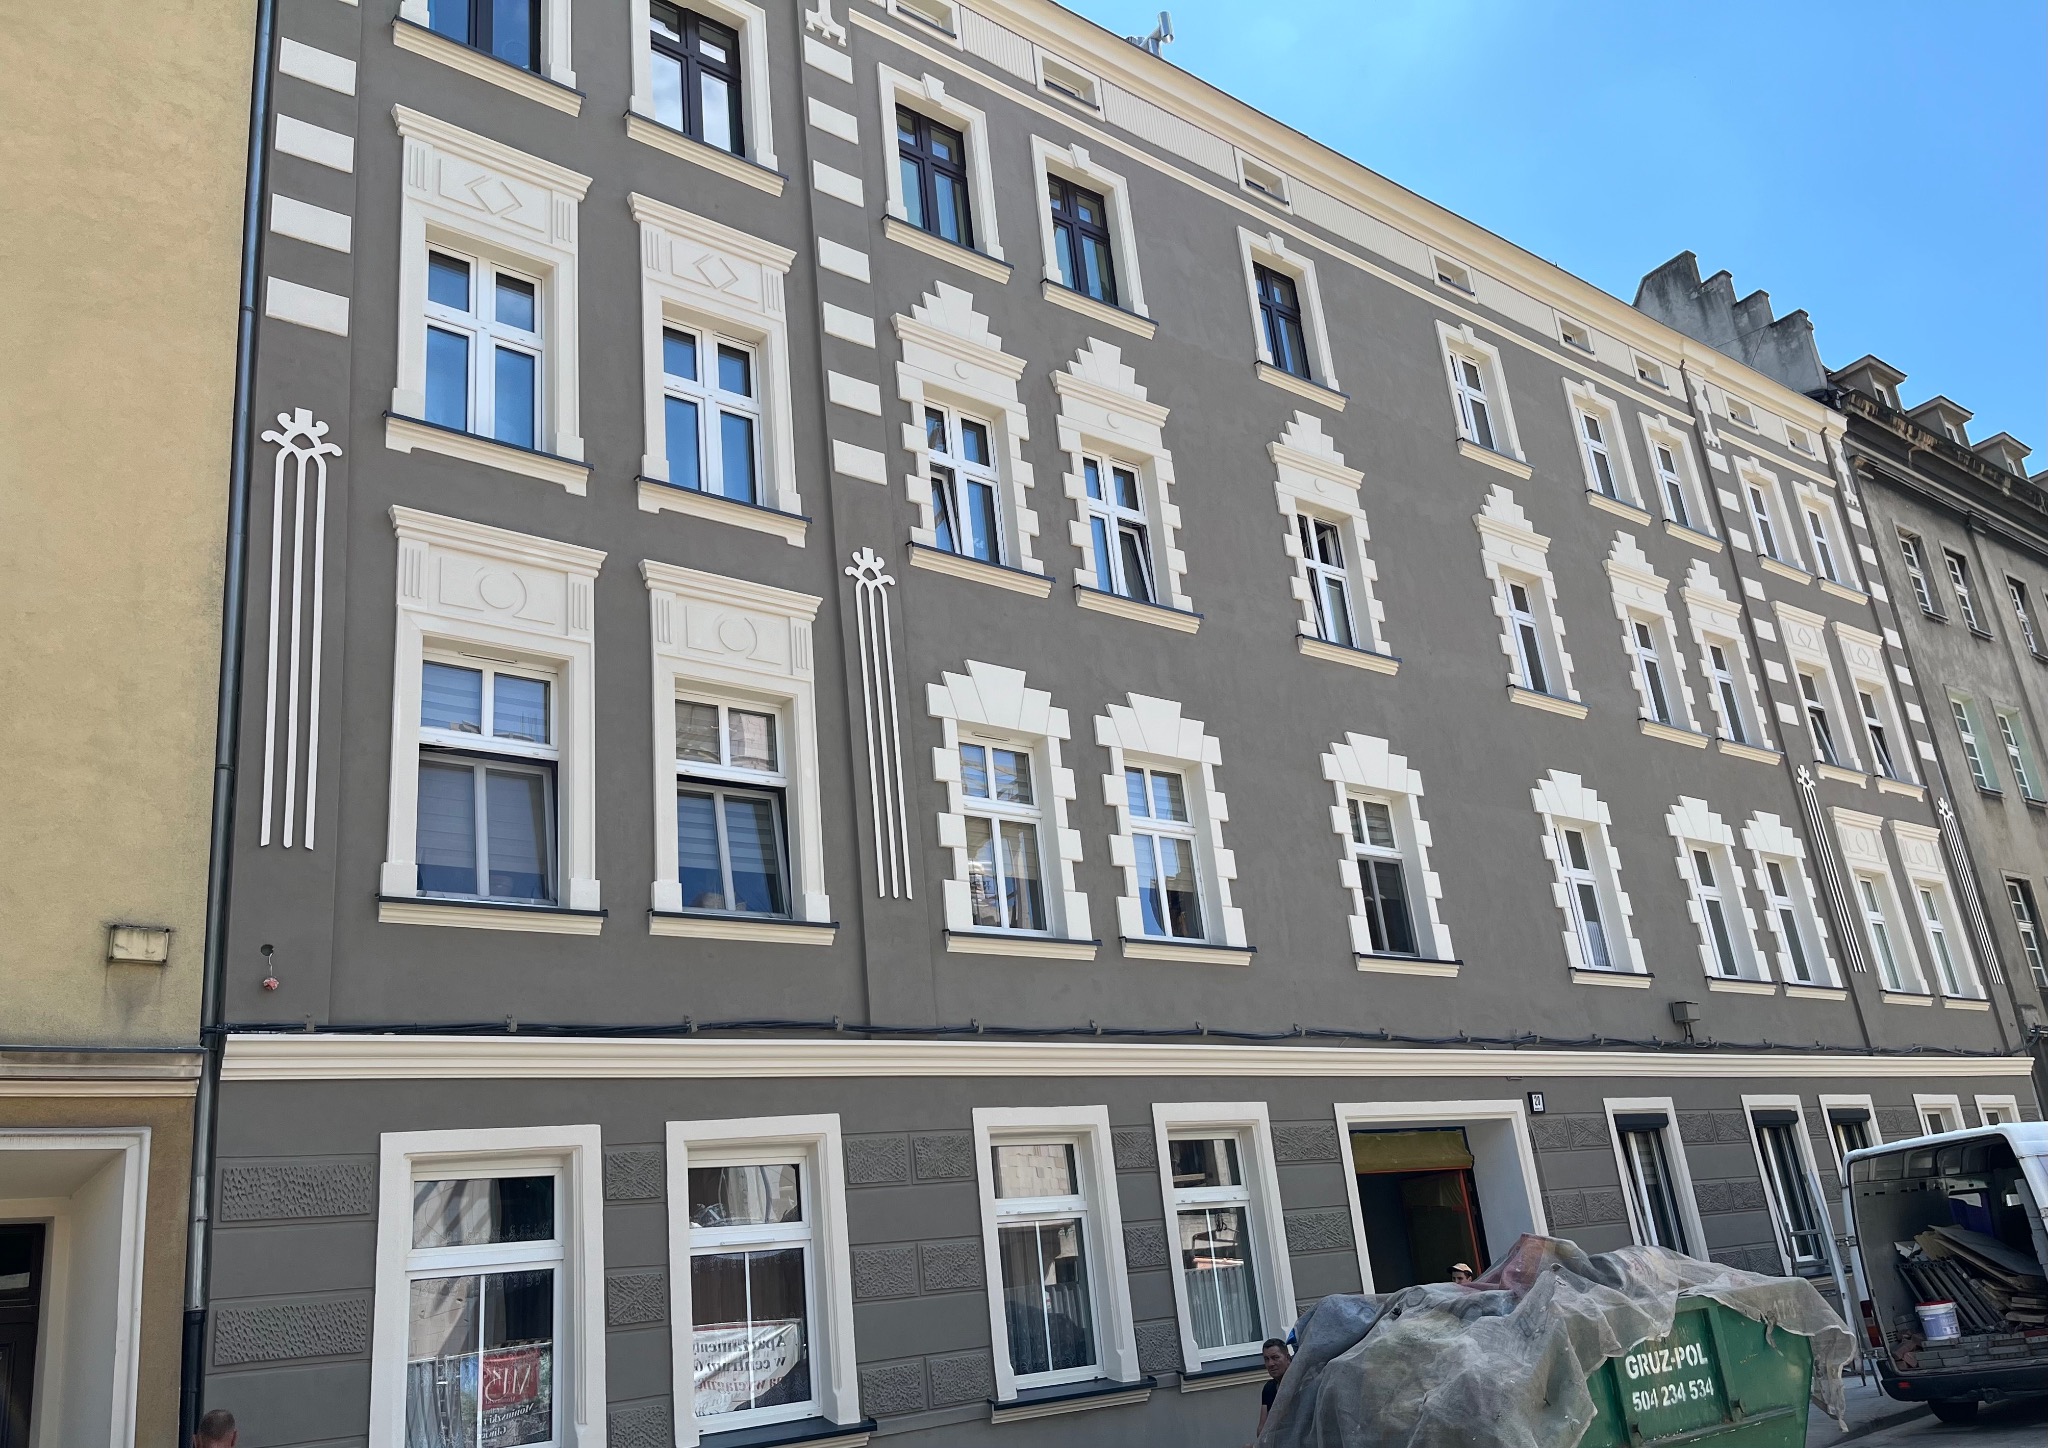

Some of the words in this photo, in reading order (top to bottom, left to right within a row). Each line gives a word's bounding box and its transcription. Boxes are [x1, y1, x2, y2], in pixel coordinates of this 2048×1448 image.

[1625, 1343, 1709, 1379] GRUZ-POL
[1632, 1389, 1659, 1412] 504
[1661, 1382, 1686, 1407] 234
[1689, 1376, 1714, 1400] 534
